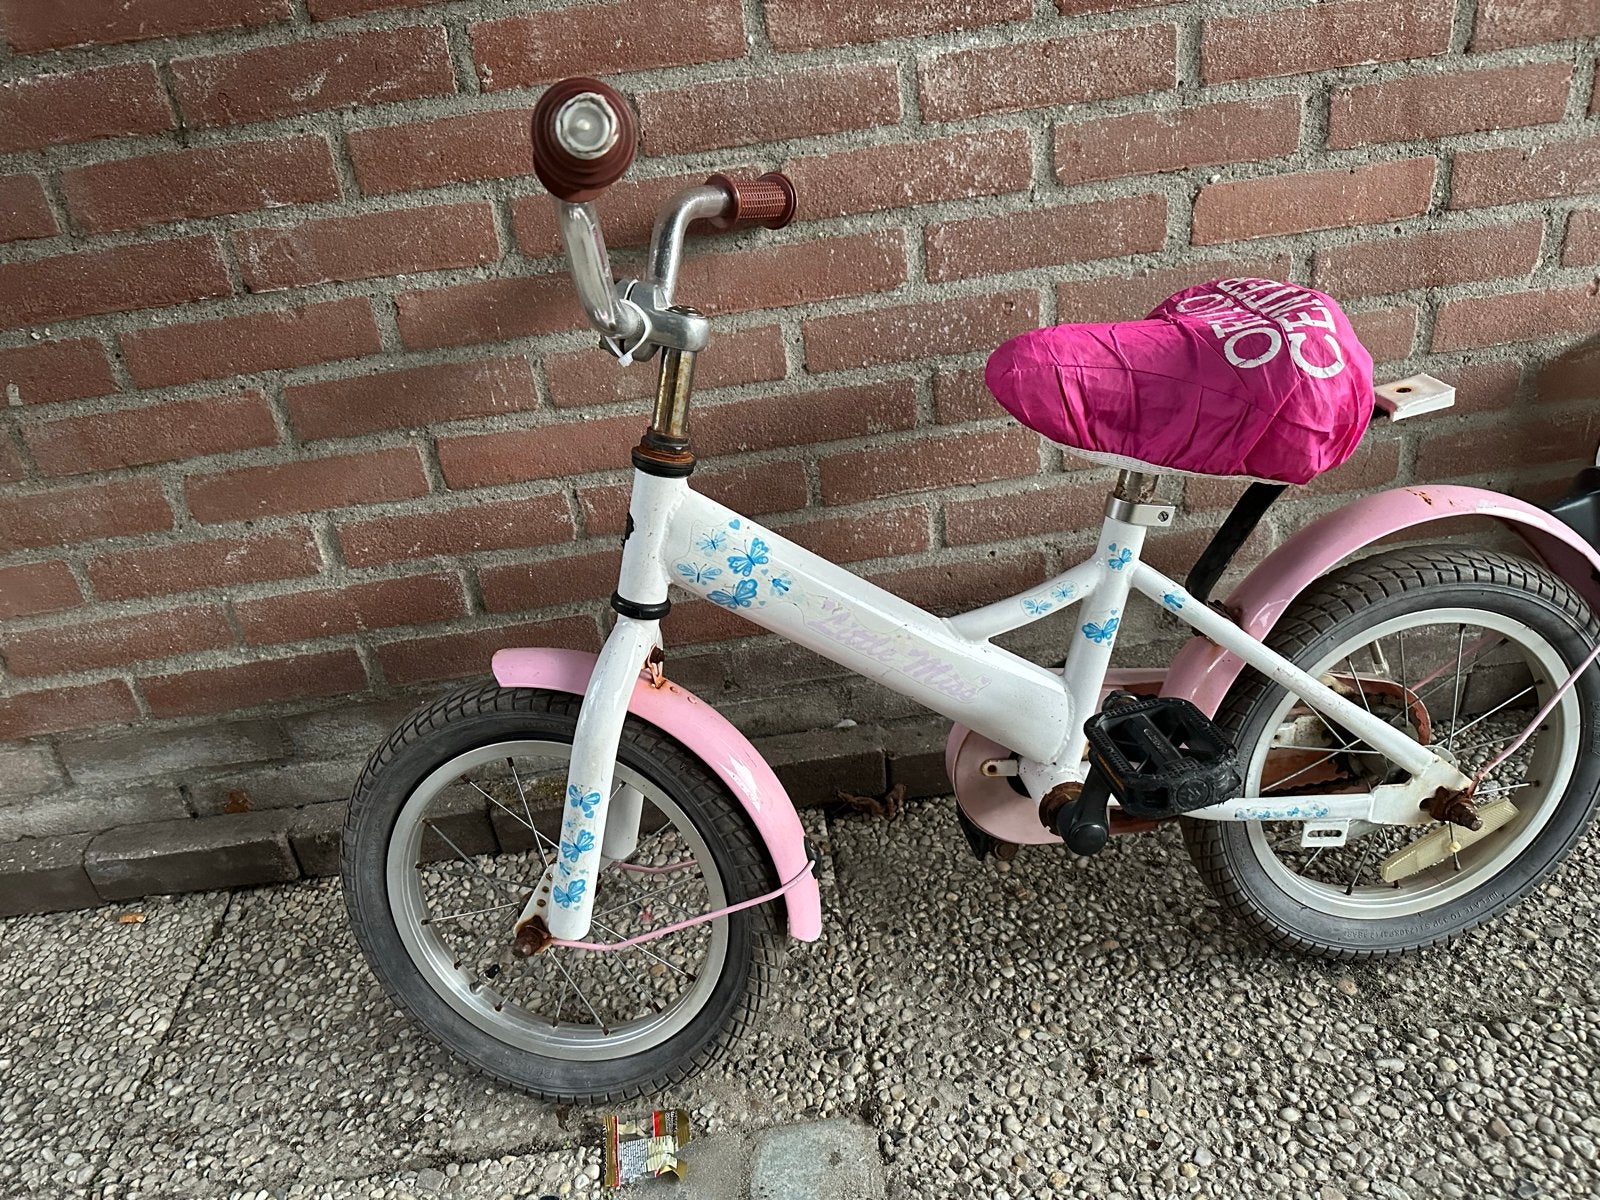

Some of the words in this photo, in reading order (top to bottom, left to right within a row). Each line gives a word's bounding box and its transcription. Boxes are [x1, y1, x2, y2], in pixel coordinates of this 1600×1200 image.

[1216, 277, 1346, 379] CENTER
[807, 605, 895, 661] Little
[902, 649, 979, 702] Miss
